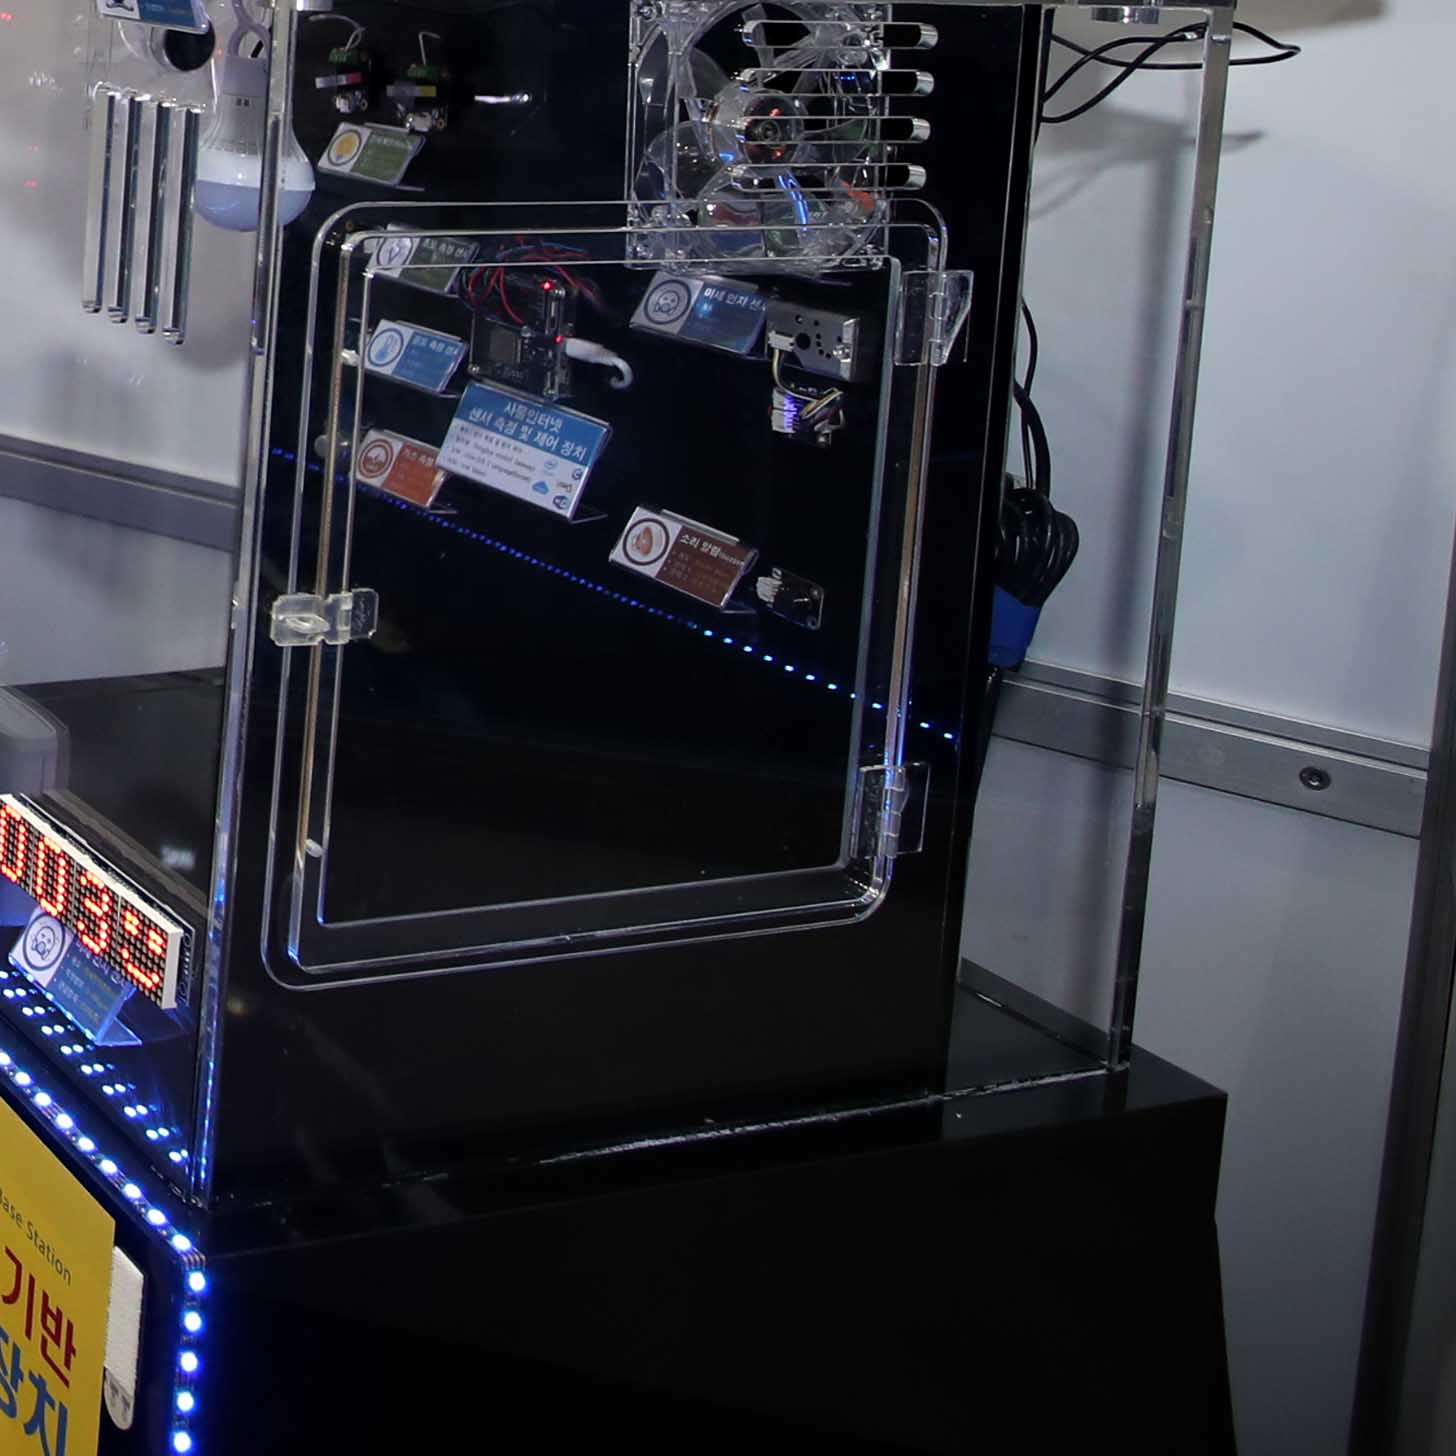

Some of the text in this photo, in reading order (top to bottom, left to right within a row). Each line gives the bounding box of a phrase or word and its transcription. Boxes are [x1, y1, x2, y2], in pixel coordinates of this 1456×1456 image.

[468, 407, 493, 423] 센서
[560, 440, 588, 462] 장치
[503, 401, 563, 433] 사물인터넷
[26, 1220, 73, 1286] Station
[0, 1245, 77, 1389] 기반
